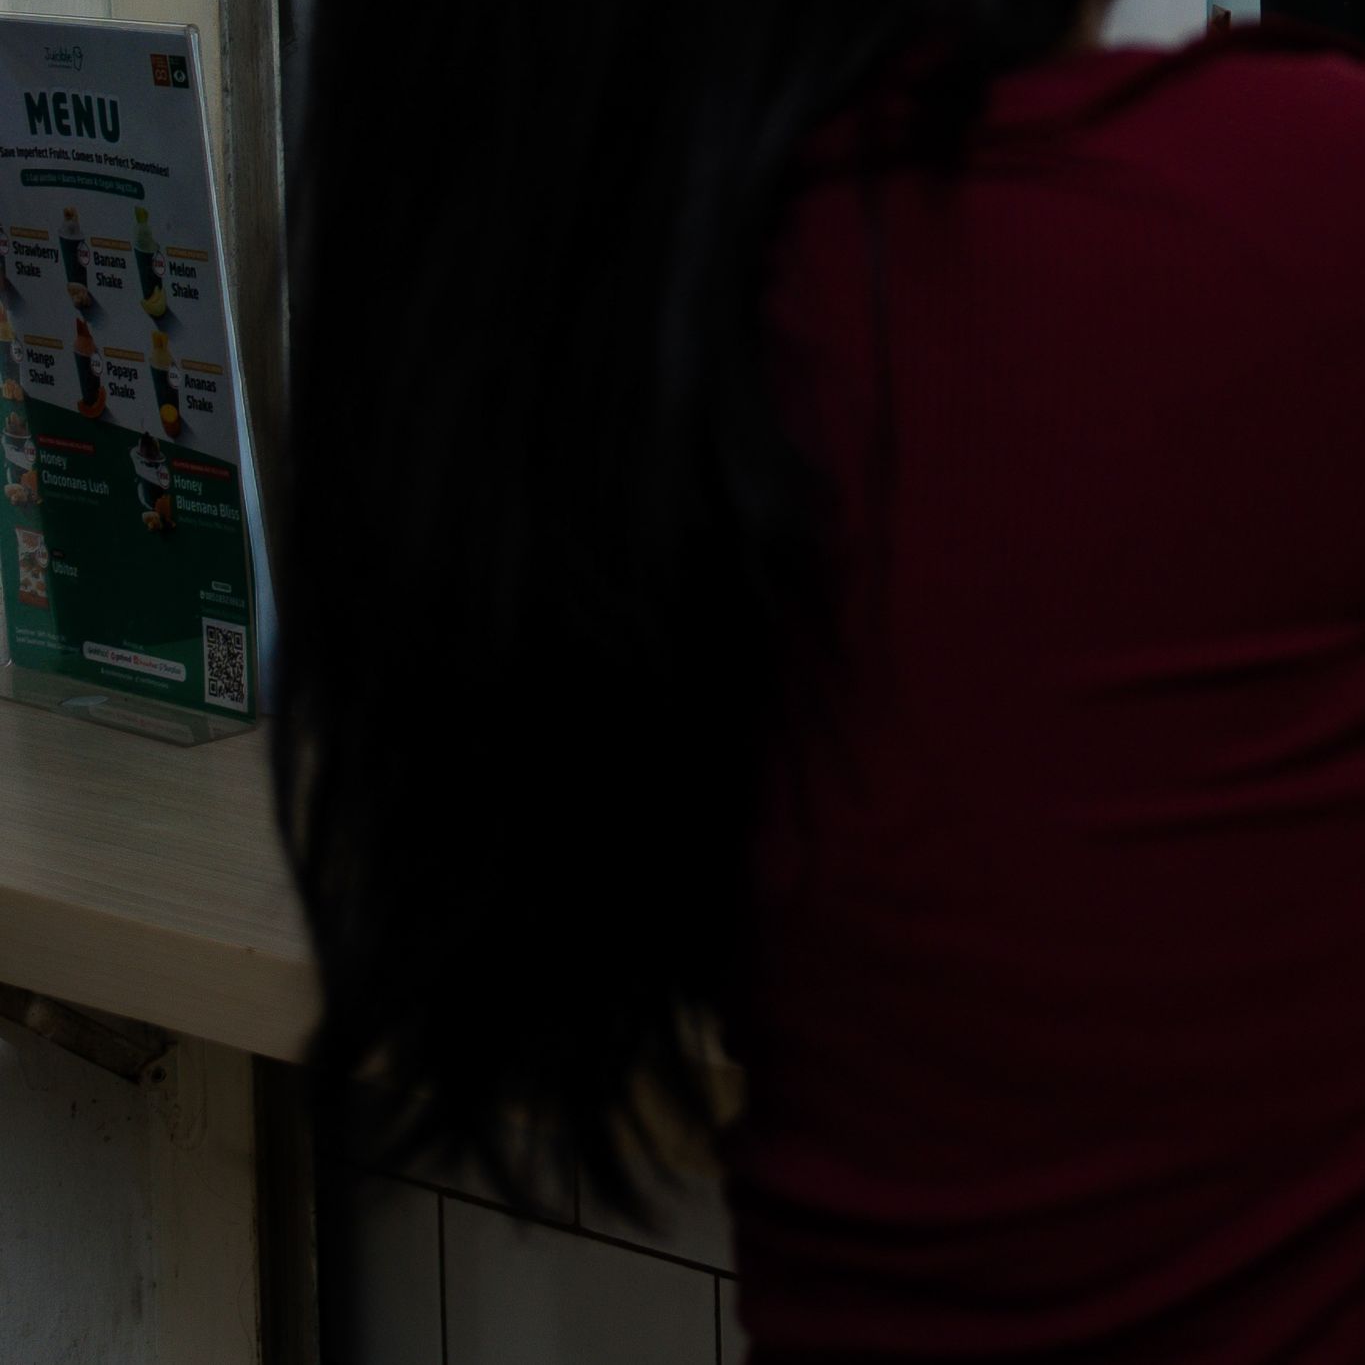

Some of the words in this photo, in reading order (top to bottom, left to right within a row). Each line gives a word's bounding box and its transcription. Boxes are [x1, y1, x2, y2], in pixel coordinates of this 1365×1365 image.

[24, 91, 121, 143] MENU
[16, 146, 48, 160] Imperfect
[72, 148, 94, 163] Comes
[95, 152, 103, 164] to
[103, 153, 129, 169] Perfect
[12, 241, 59, 263] Strawberry
[93, 252, 126, 269] Banana
[15, 262, 41, 277] Shake
[169, 262, 196, 278] Melon
[96, 273, 123, 289] Shake
[172, 283, 199, 300] Shake
[26, 348, 55, 368] Mango
[29, 369, 55, 386] Shake
[106, 361, 138, 382] Papaya
[109, 383, 136, 400] Shake
[184, 374, 217, 392] Ananas
[187, 395, 214, 412] Shake
[39, 450, 67, 469] Honey
[42, 470, 87, 491] Choconana
[88, 478, 110, 497] Lush
[173, 474, 203, 495] Honey
